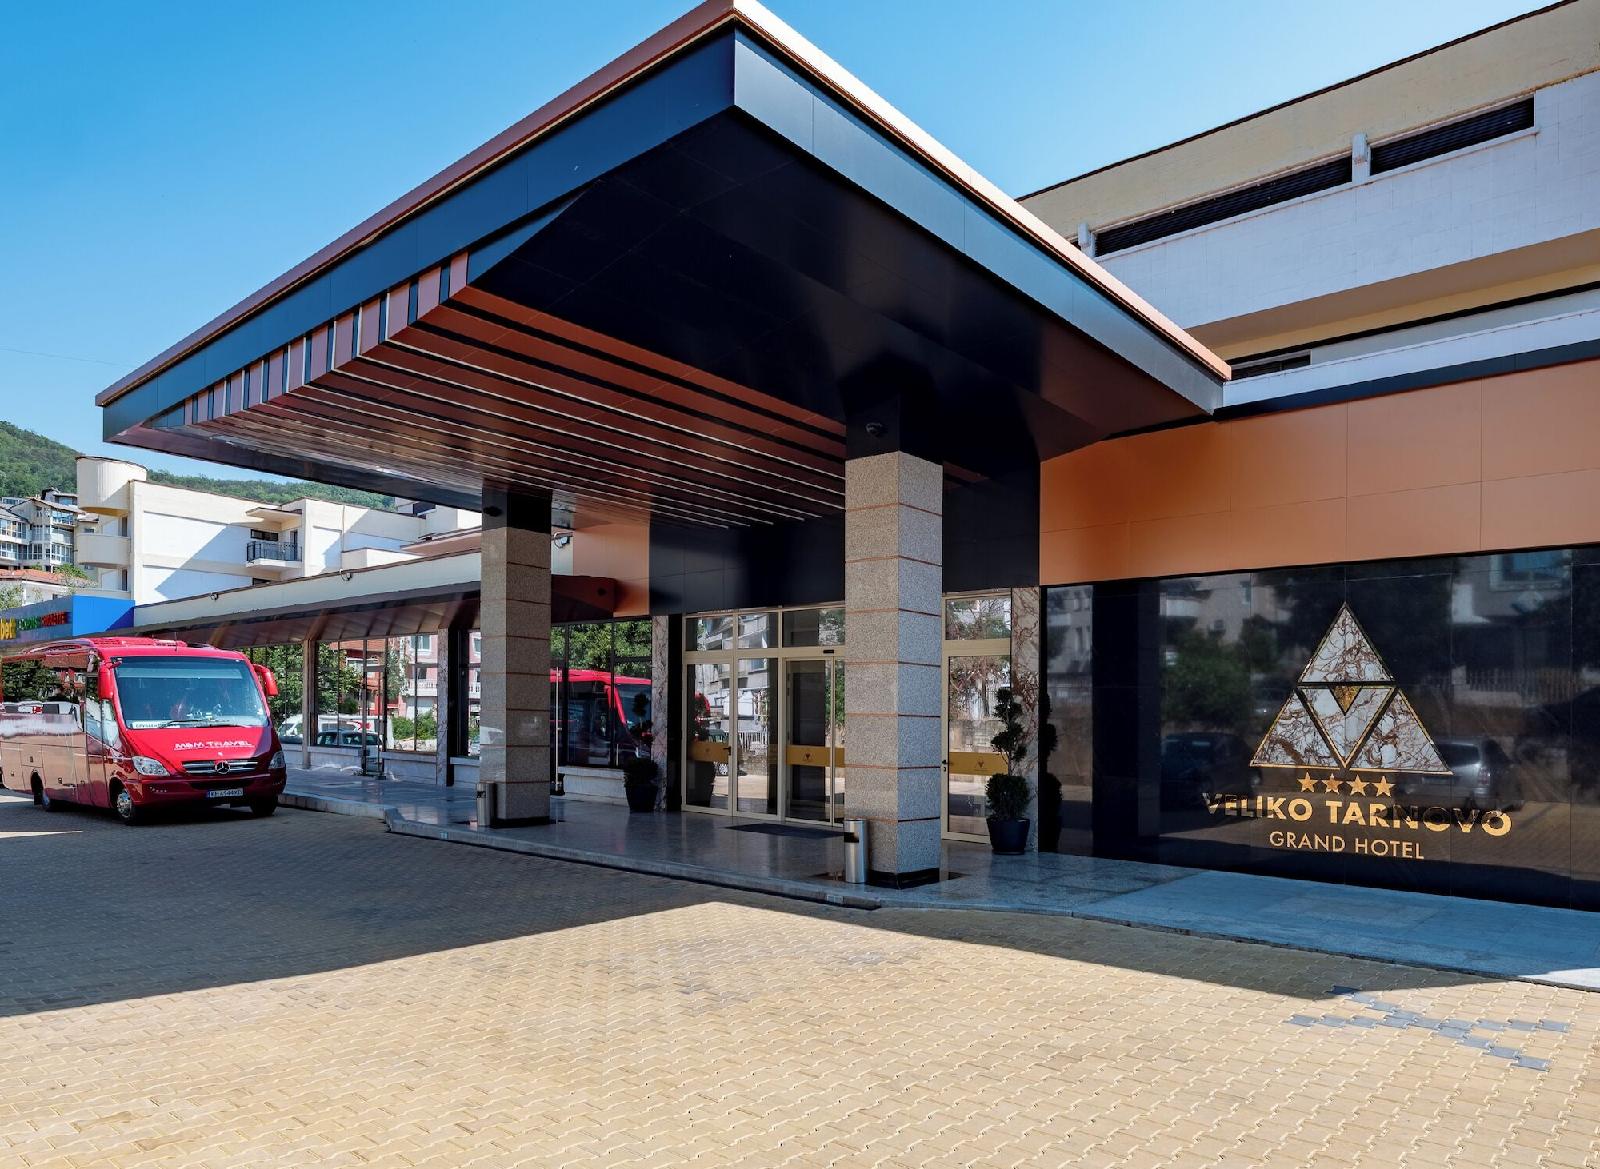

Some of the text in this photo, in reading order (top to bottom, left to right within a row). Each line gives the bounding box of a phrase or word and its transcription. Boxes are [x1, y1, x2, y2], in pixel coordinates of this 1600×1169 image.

[1201, 792, 1512, 836] VELIKO TARNOVO
[1269, 831, 1425, 859] GRAND HOTEL
